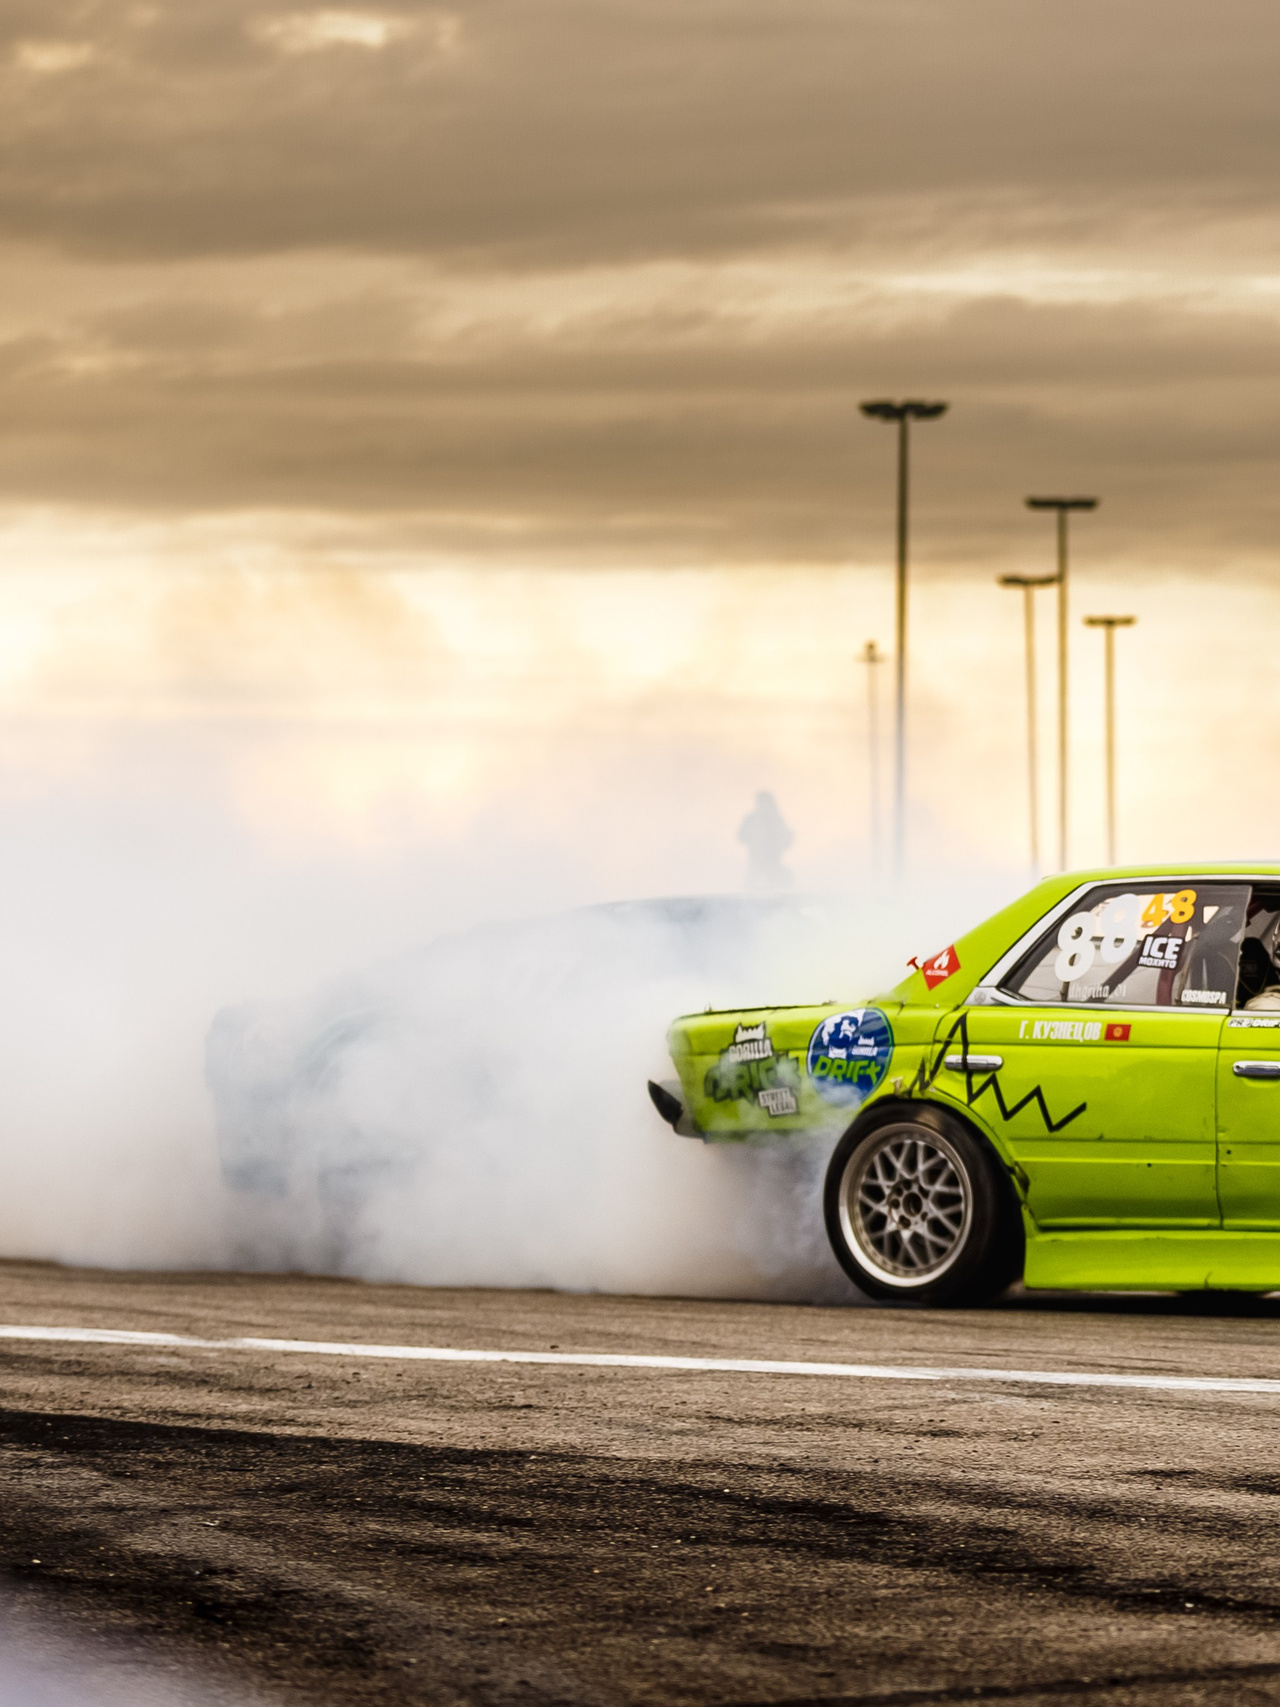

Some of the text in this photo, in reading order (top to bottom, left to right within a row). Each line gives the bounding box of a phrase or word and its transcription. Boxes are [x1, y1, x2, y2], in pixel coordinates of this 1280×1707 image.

[1140, 889, 1197, 928] 48
[1054, 893, 1141, 982] 88
[1142, 936, 1183, 960] ICE
[1181, 989, 1227, 1004] COSMOSPA
[1018, 1020, 1103, 1043] Г. КУЗНЕЦОВ
[728, 1039, 773, 1063] GORILLA
[813, 1055, 881, 1084] DRIFT
